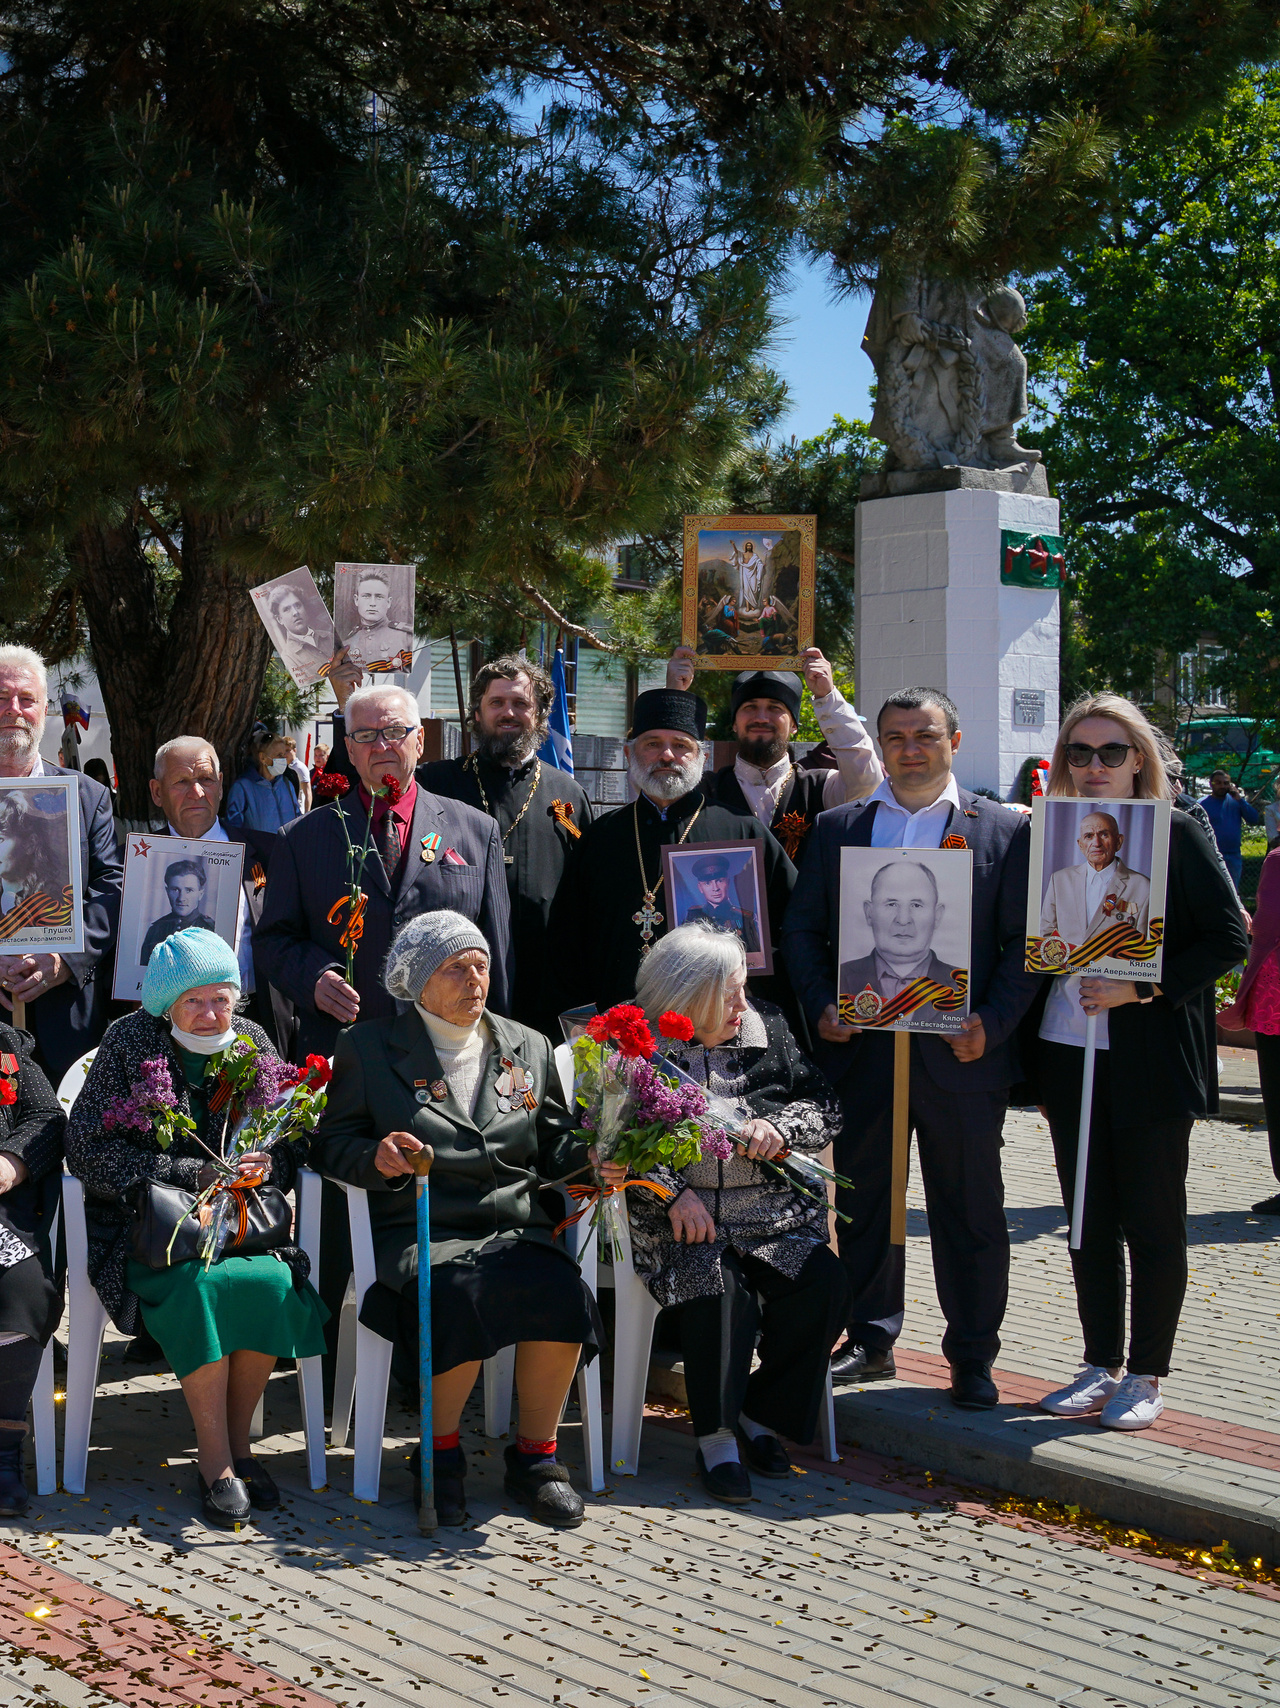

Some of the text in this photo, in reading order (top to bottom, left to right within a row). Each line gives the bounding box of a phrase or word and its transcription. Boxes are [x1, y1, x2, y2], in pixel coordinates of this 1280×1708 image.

[43, 927, 74, 935] Глушко
[1128, 960, 1158, 969] Кялов
[920, 1020, 962, 1030] Евстафьеви
